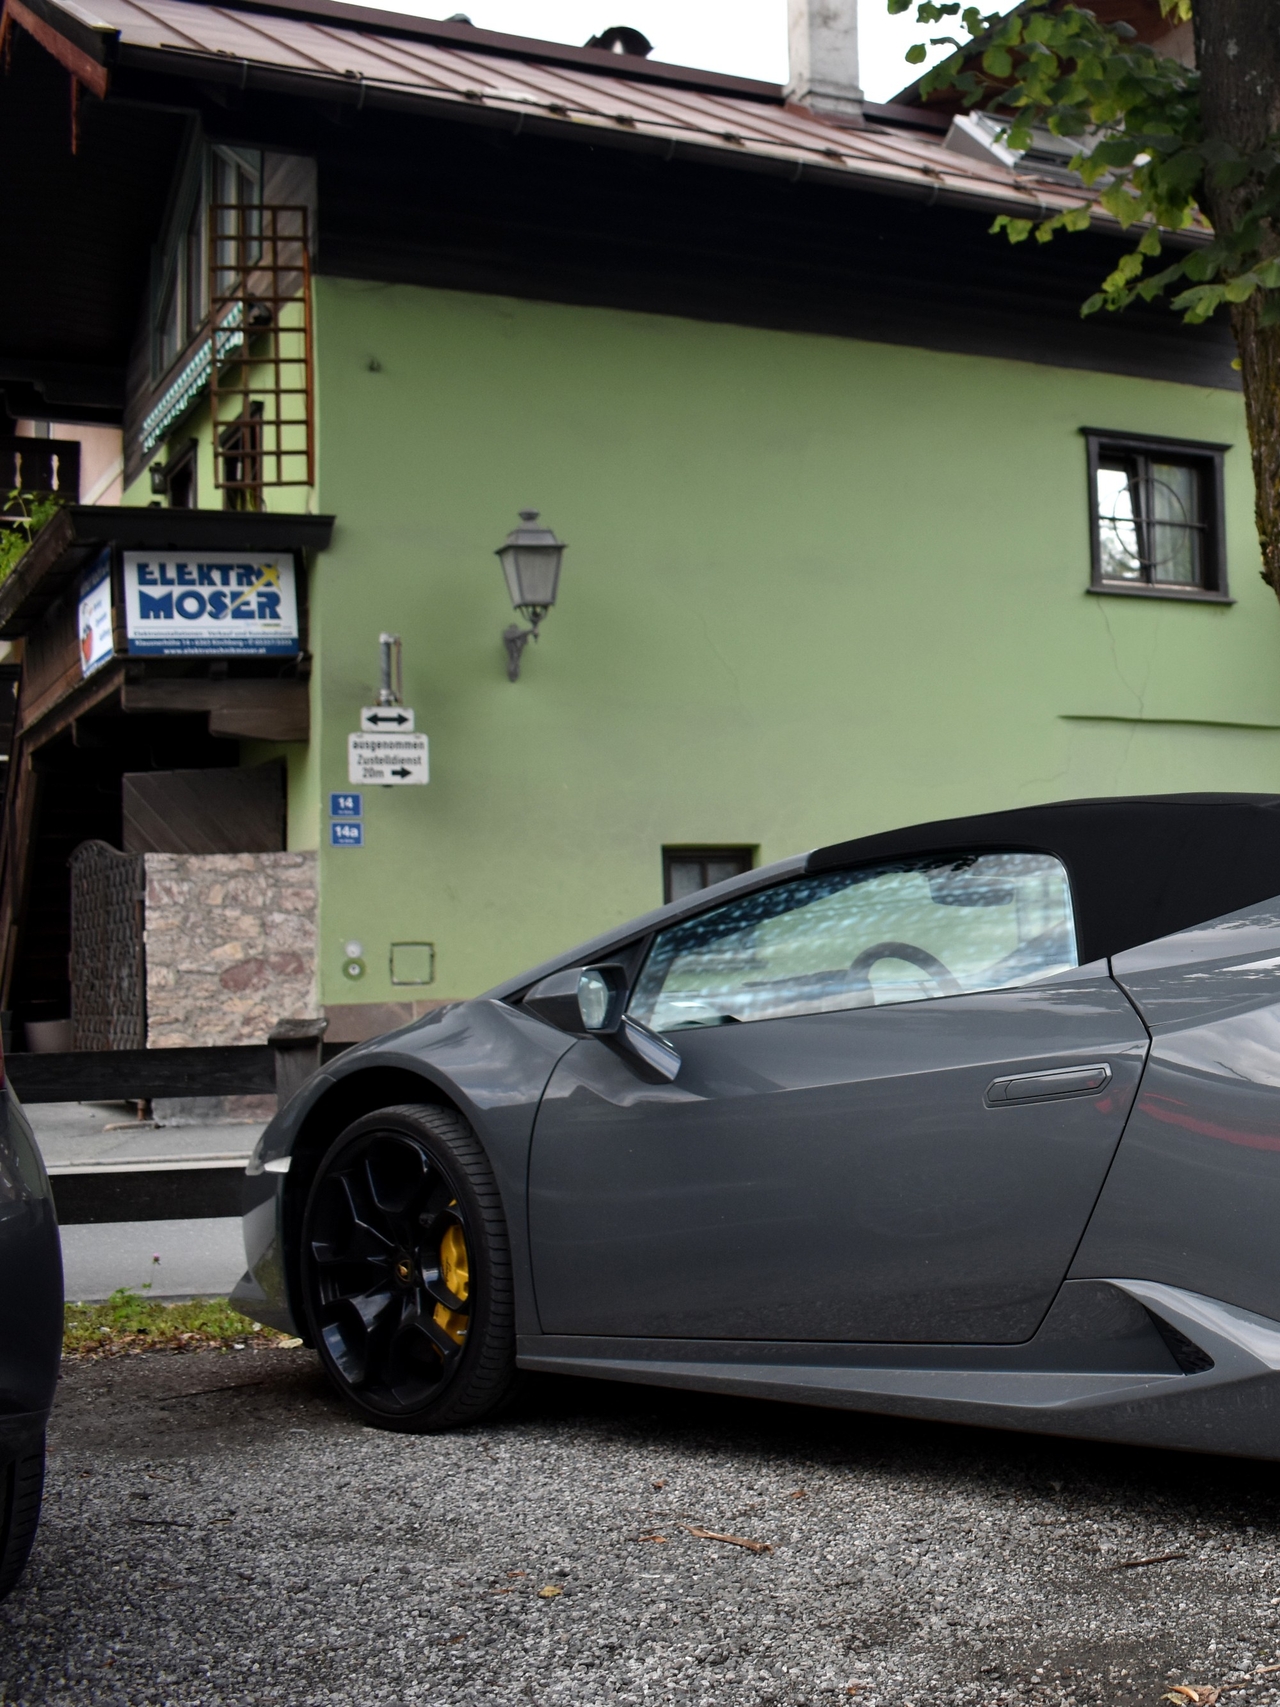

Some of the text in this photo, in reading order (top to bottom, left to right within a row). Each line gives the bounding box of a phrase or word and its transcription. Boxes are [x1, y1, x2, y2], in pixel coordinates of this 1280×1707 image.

[138, 589, 282, 620] MOSER
[352, 740, 425, 752] ausgenommen
[357, 753, 422, 765] Zustelldienst
[363, 767, 385, 778] 20m
[338, 796, 354, 809] 14
[334, 825, 359, 838] 14a
